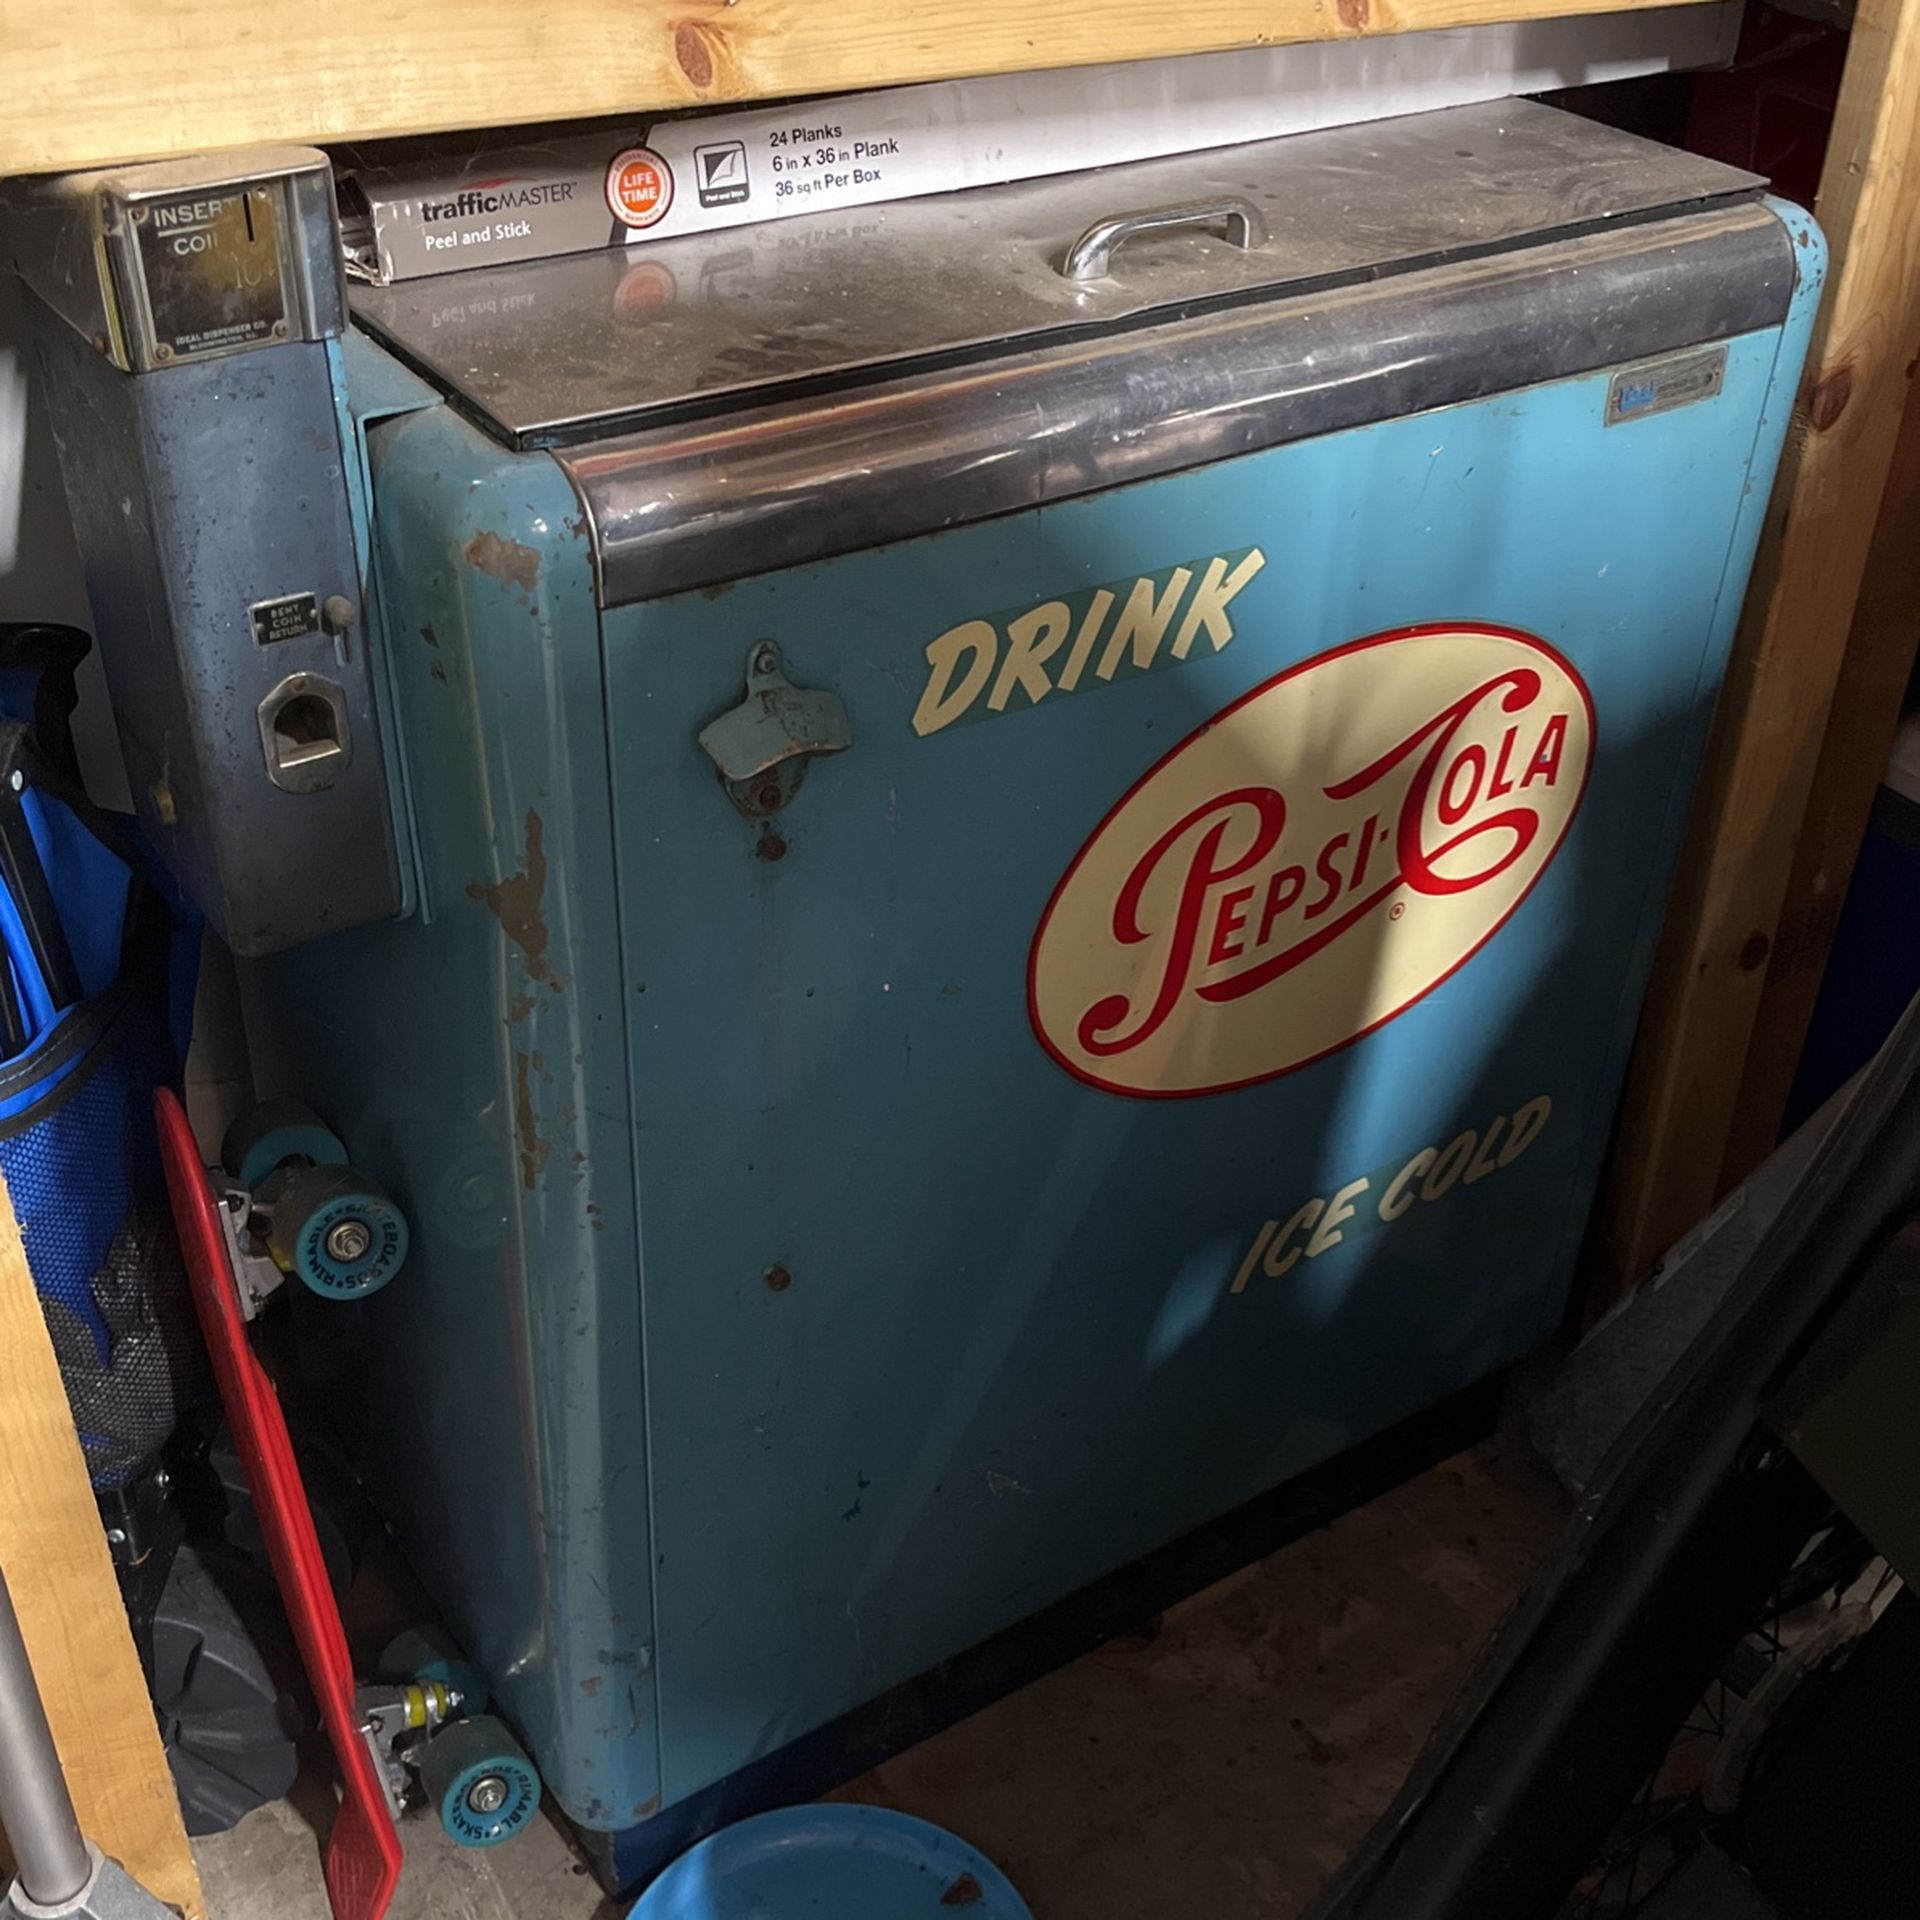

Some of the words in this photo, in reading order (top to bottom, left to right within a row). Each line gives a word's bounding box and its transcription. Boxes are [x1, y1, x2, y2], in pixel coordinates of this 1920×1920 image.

[769, 131, 788, 147] 24
[792, 124, 843, 145] Planks
[772, 155, 783, 172] 6
[786, 155, 798, 170] in
[802, 154, 812, 167] x
[816, 147, 835, 166] 36
[838, 149, 850, 162] in
[854, 138, 900, 159] Plank
[623, 171, 654, 188] LIFE
[775, 180, 794, 197] 36
[797, 183, 811, 196] sq
[813, 179, 823, 192] ft
[825, 172, 849, 189] Per
[853, 168, 882, 184] Box
[622, 186, 658, 204] TIME
[425, 230, 458, 251] Peel
[462, 225, 491, 245] and
[495, 220, 531, 241] Stick
[270, 603, 299, 619] BENT
[272, 614, 302, 629] COIN
[269, 622, 308, 641] RETURN
[911, 546, 1266, 738] DRINK
[1229, 1176, 1371, 1294] ICE
[1377, 1094, 1553, 1223] COLD
